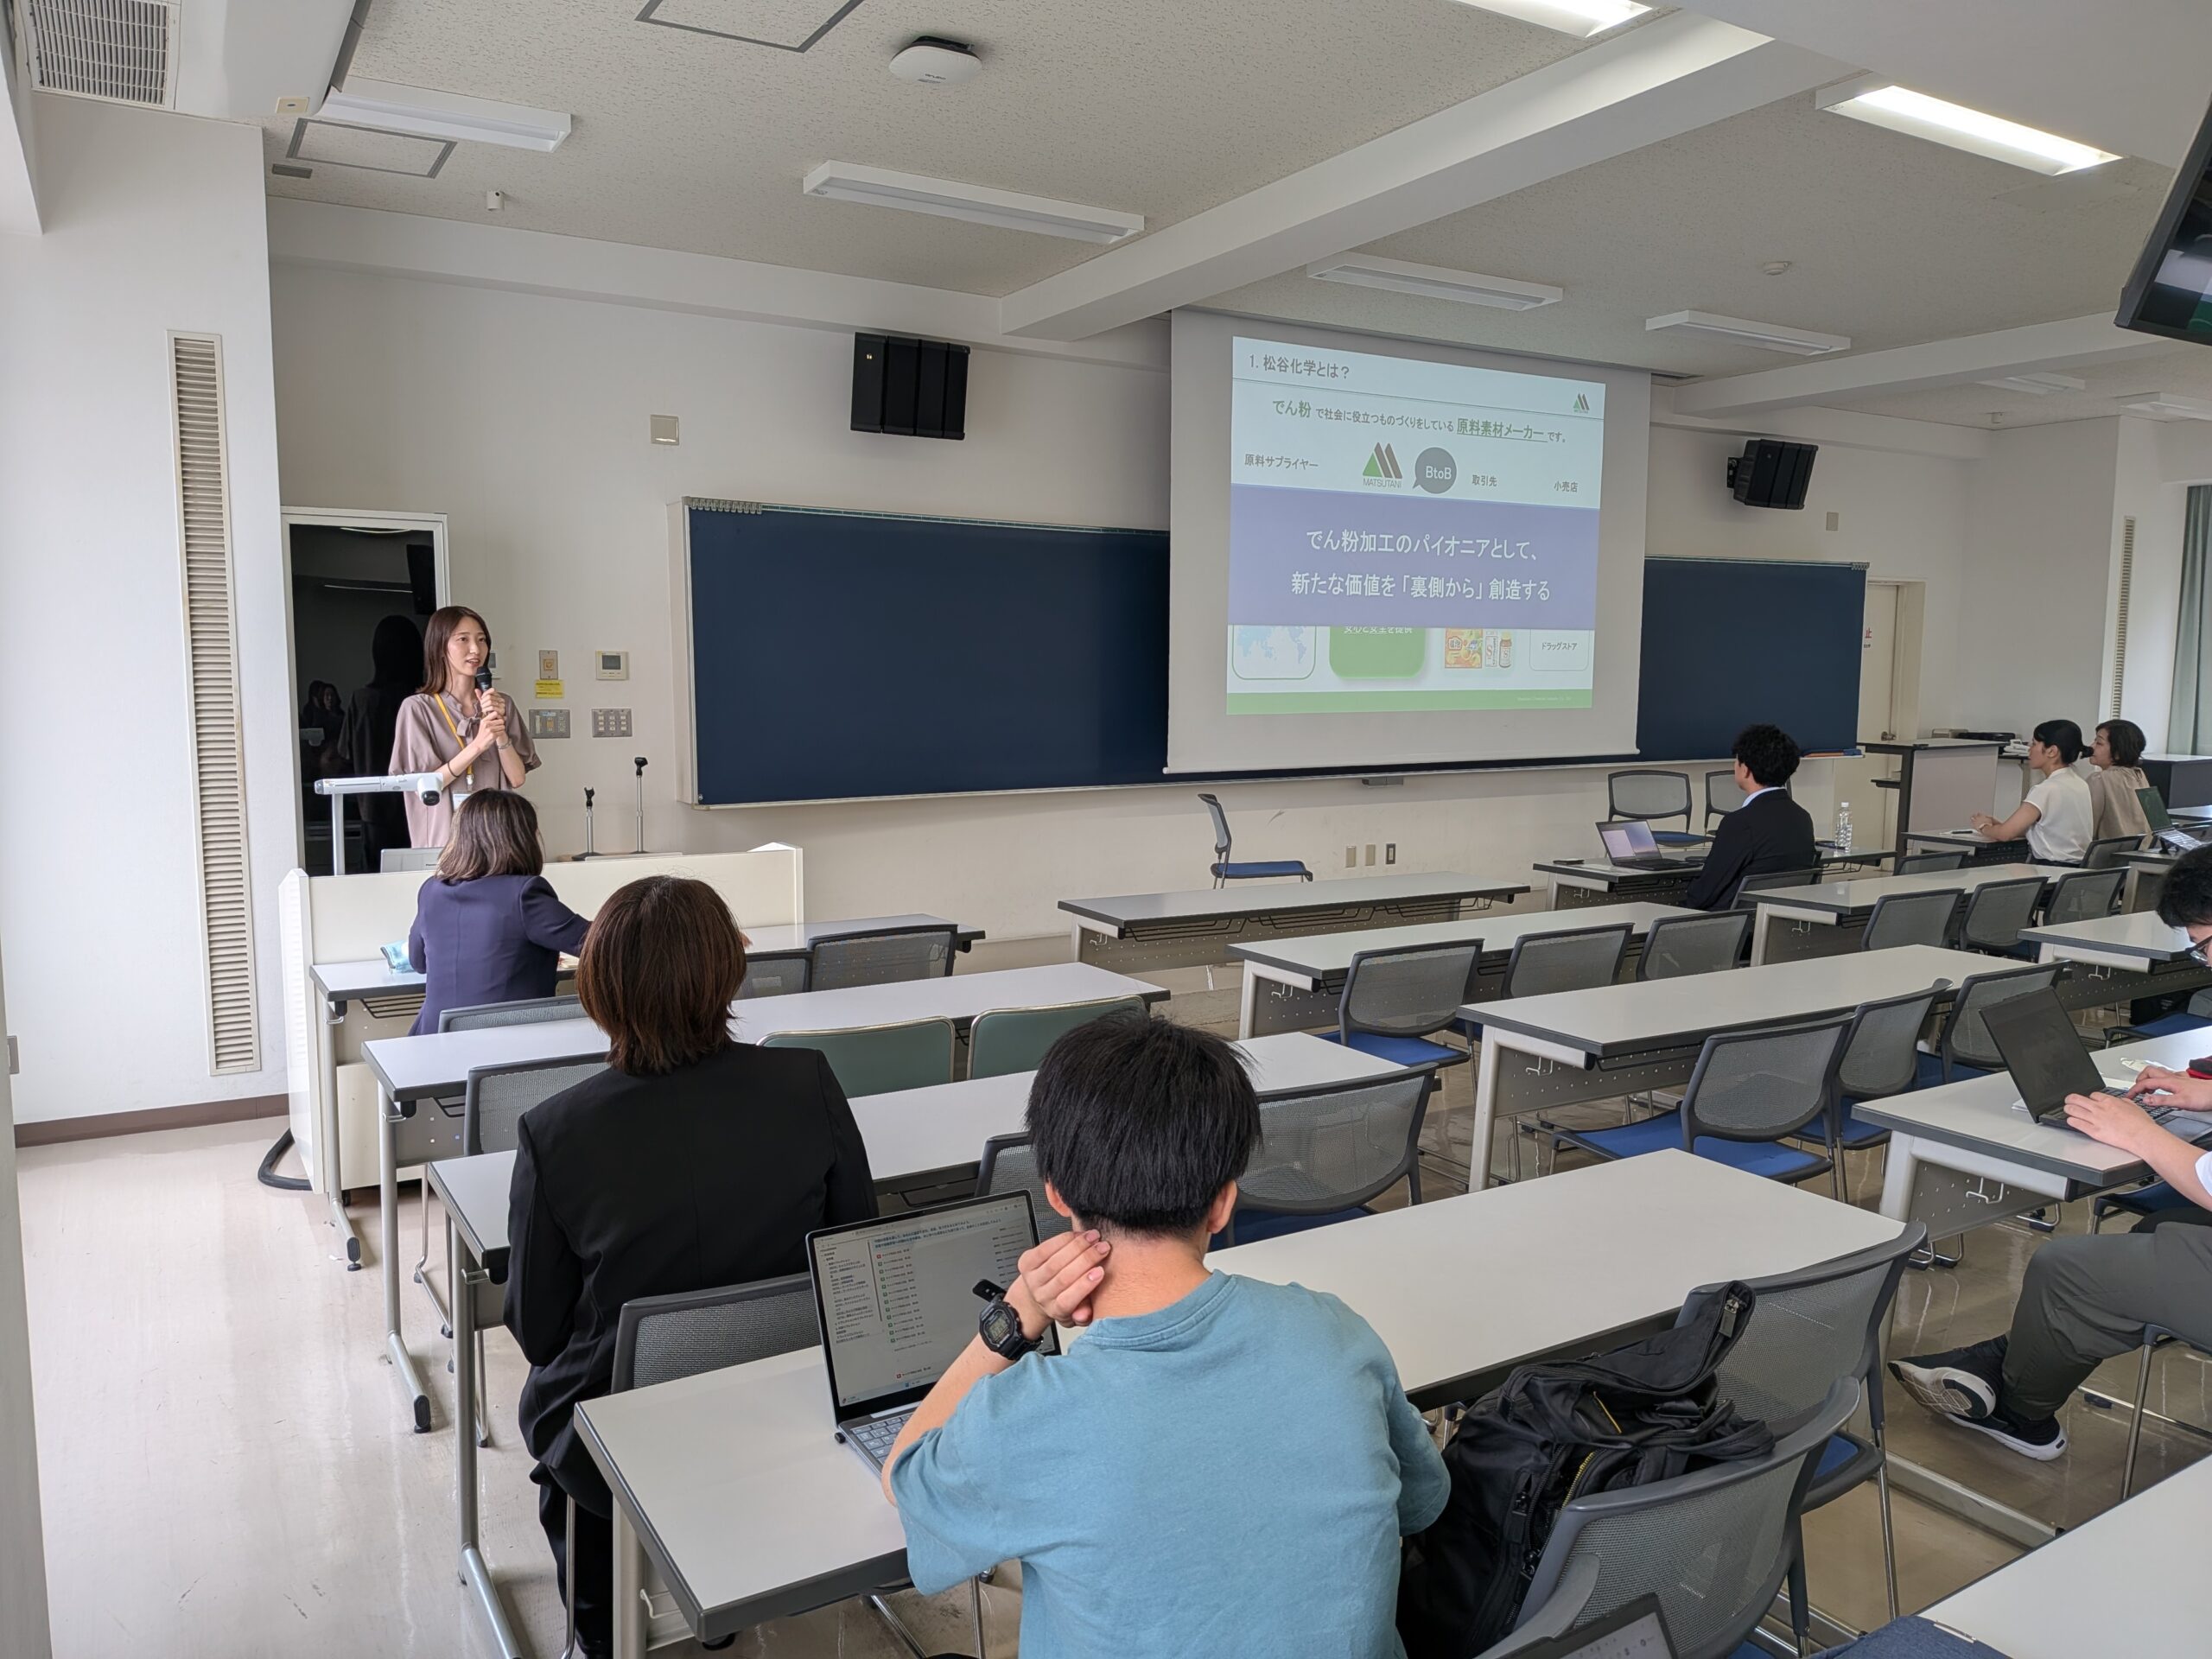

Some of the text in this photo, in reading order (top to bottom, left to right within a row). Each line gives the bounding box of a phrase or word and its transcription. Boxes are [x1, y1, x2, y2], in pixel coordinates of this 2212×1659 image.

[1263, 354, 1350, 379] 松谷化学とは？
[1273, 400, 1312, 418] でん粉
[1457, 417, 1545, 439] 原料素材メーカー
[1426, 465, 1452, 480] BtoB
[1363, 478, 1402, 489] MATSUTANI
[1471, 474, 1497, 487] 取引先
[1554, 480, 1579, 493] 小売店
[1306, 529, 1537, 561] でん粉加工のパイオニアとして、
[1541, 642, 1578, 651] ドラッグストア
